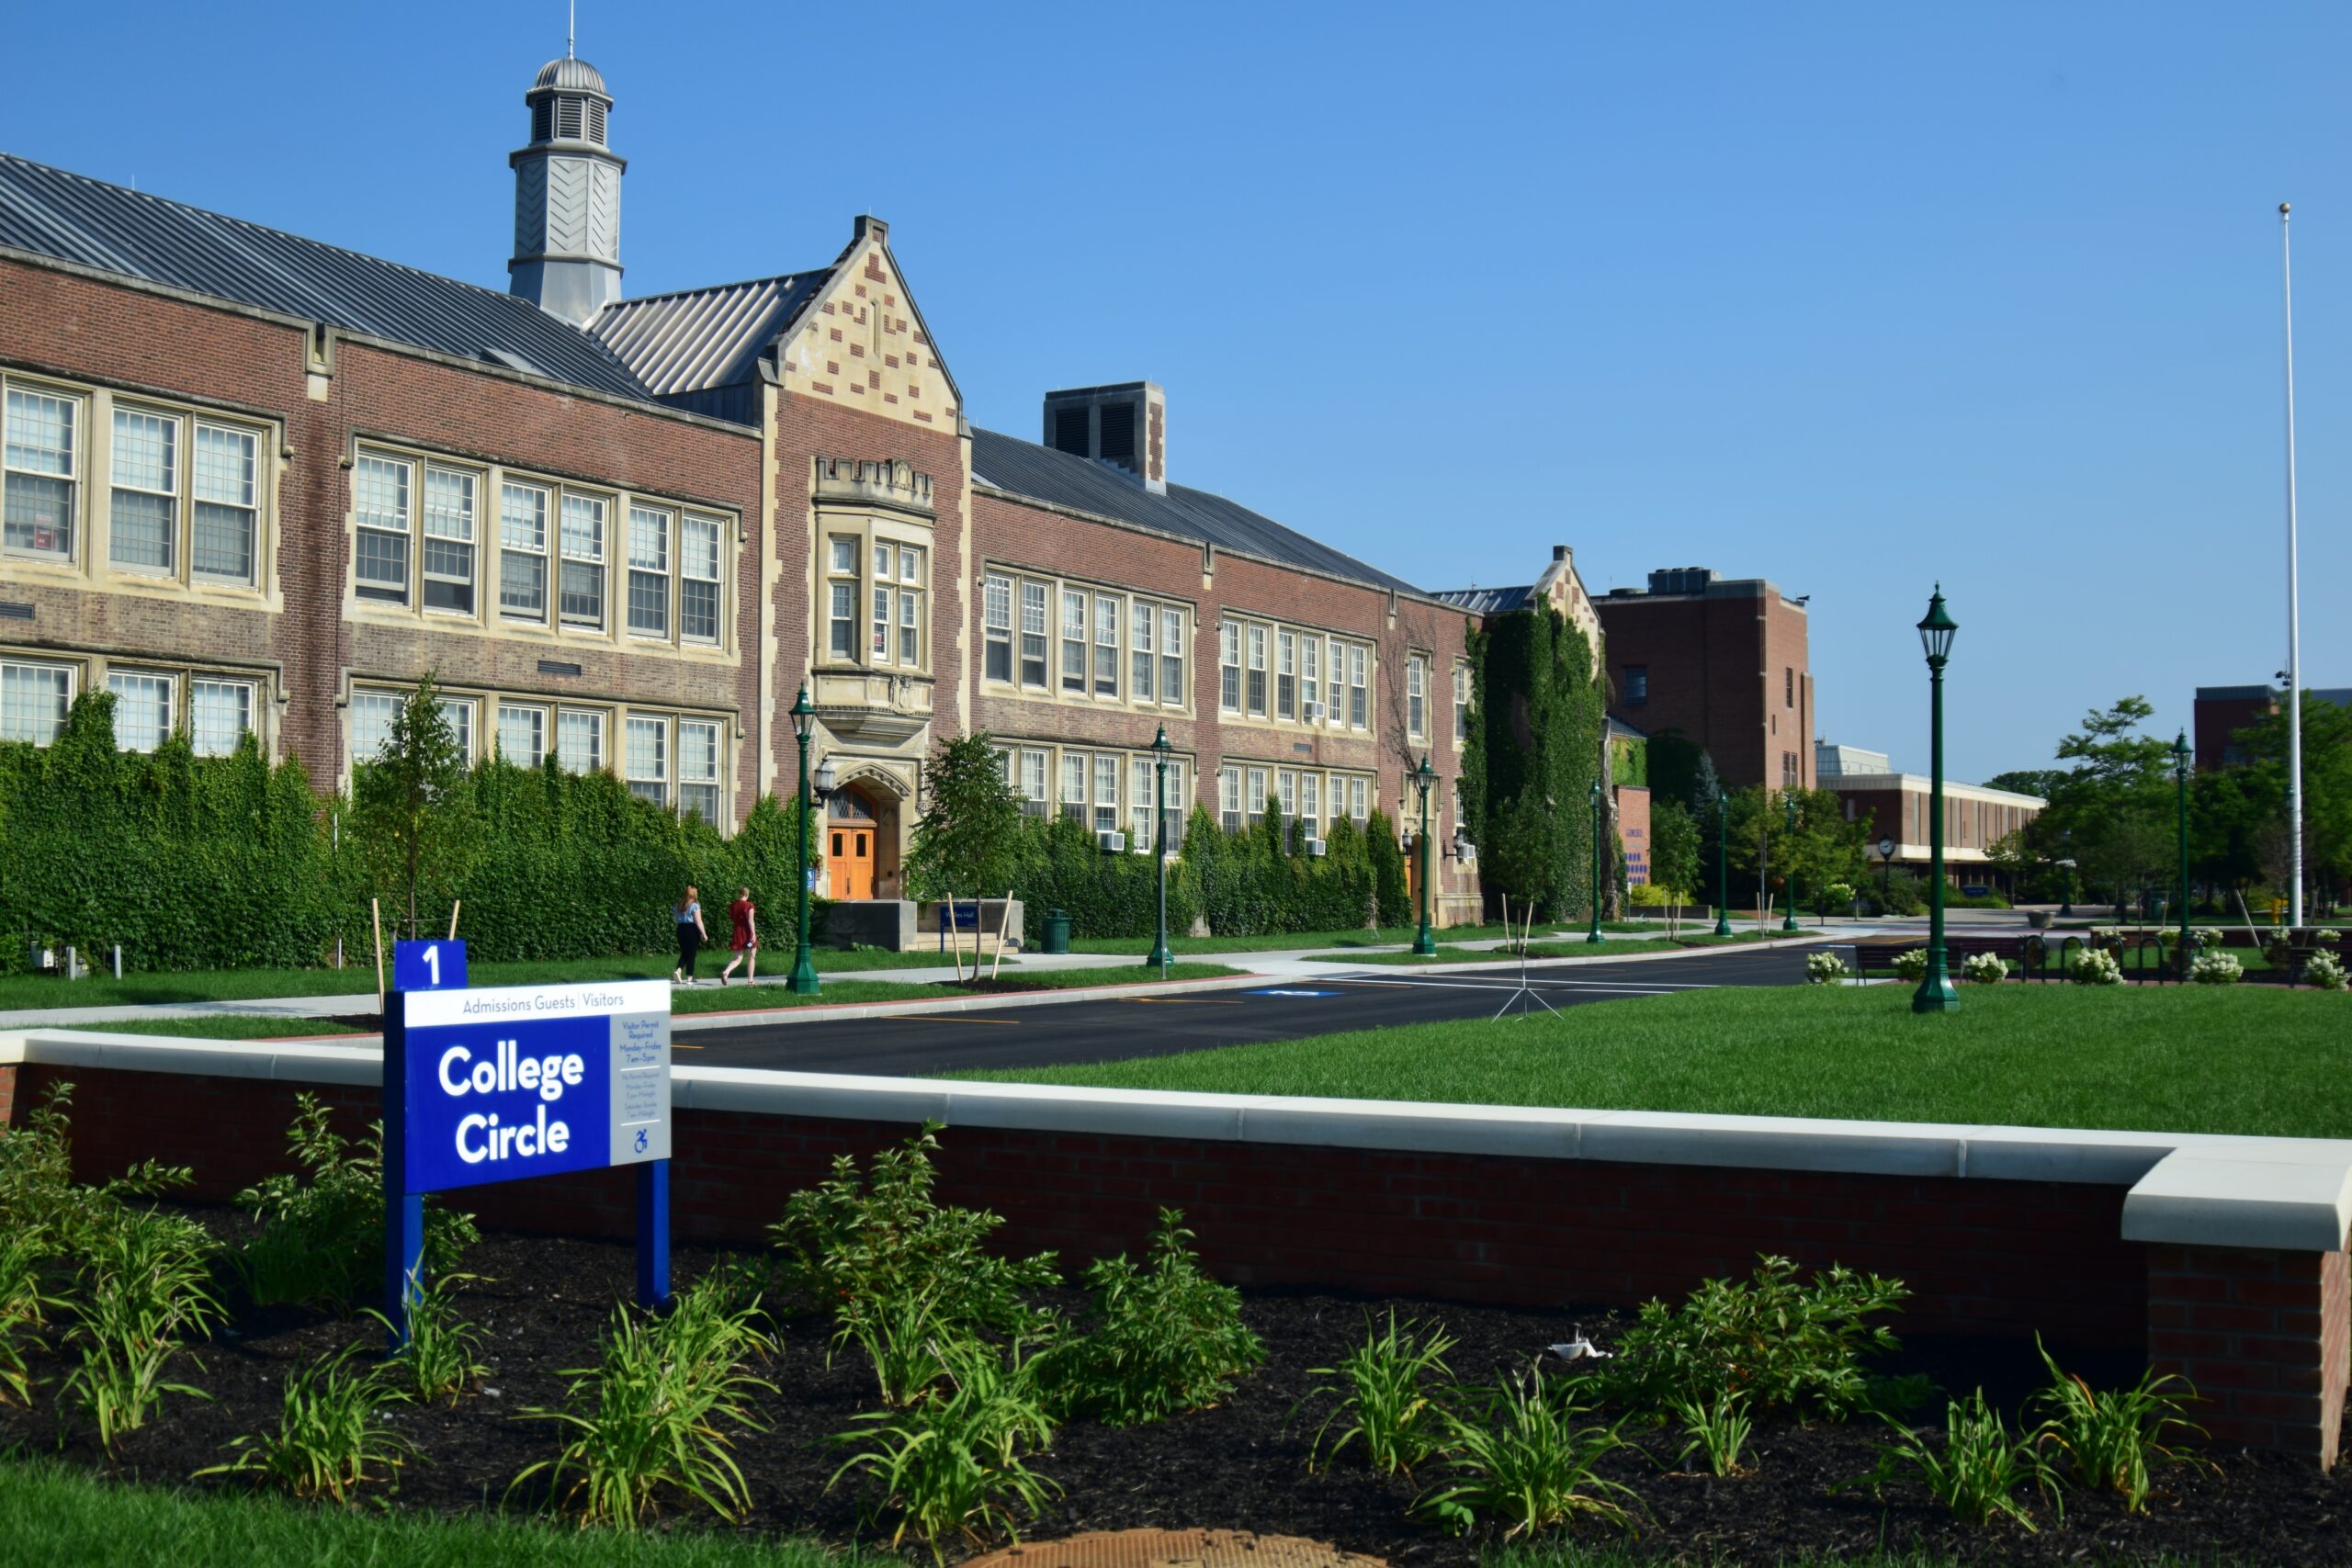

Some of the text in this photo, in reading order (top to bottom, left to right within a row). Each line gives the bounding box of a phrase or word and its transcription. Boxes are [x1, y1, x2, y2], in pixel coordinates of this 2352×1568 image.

[422, 945, 440, 985] 1
[463, 992, 624, 1014] Admissions Guests Visitors
[622, 1020, 659, 1030] Visitor Permit
[628, 1030, 653, 1041] Required
[438, 1039, 584, 1100] College
[455, 1104, 570, 1164] Circle
